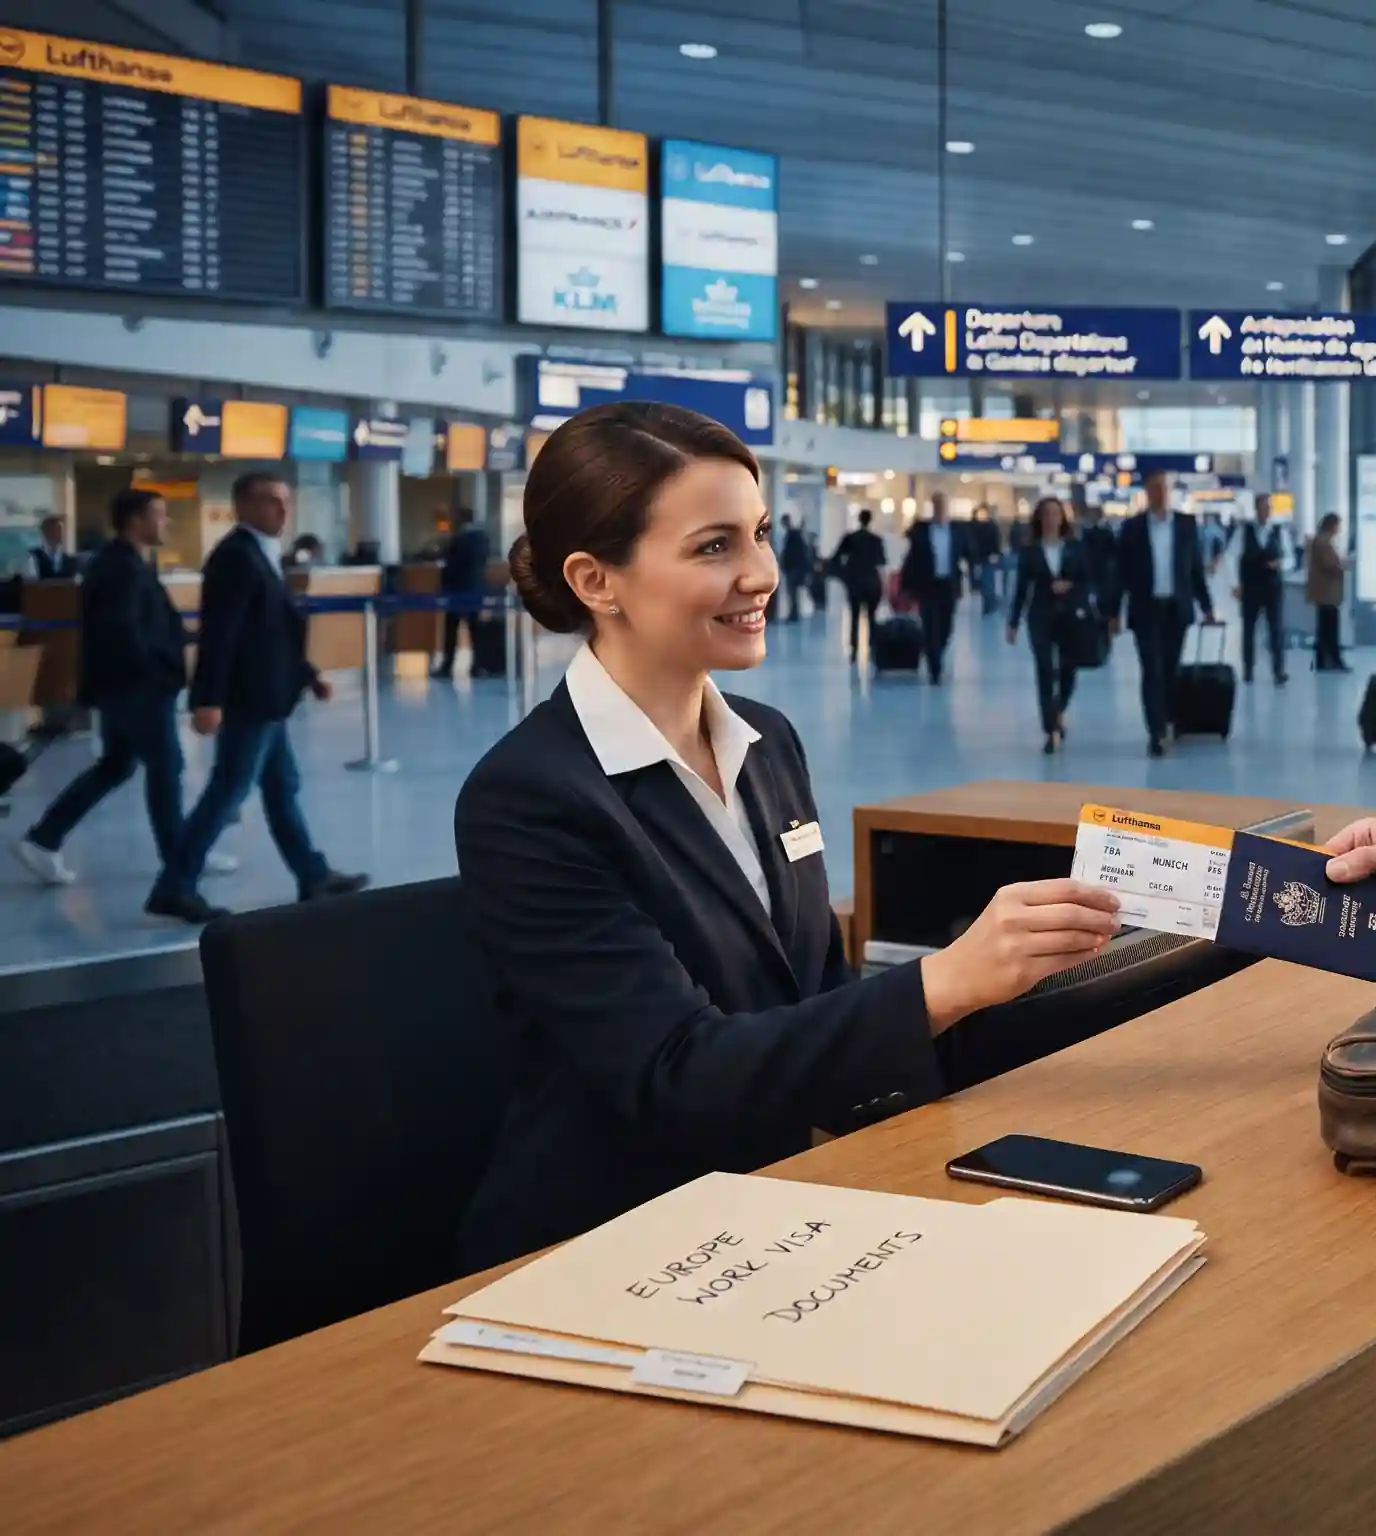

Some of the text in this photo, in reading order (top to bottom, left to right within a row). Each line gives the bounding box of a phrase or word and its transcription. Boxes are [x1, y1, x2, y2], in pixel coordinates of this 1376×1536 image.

[1111, 813, 1162, 832] Lufthansa
[625, 1230, 745, 1300] EUROPE
[675, 1219, 832, 1305] WORK VISA
[761, 1230, 923, 1324] DOCUMENTS
